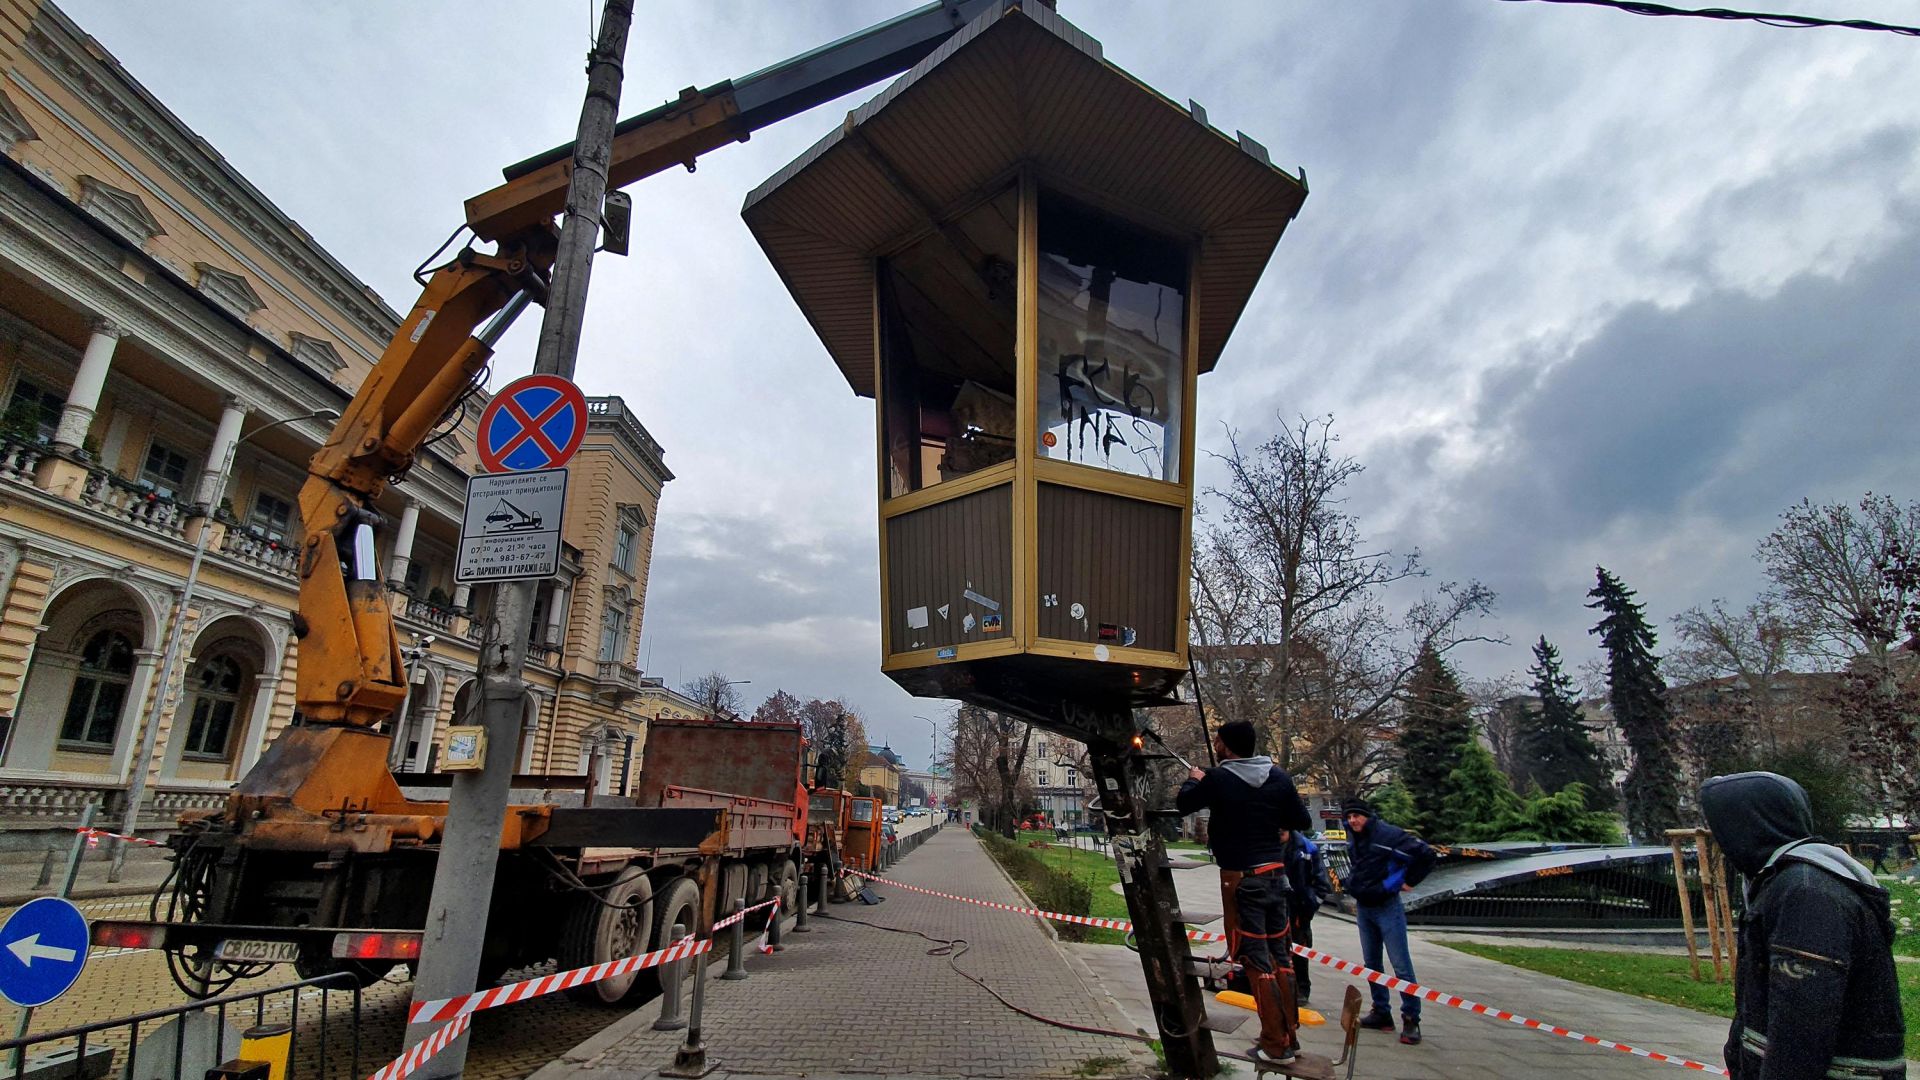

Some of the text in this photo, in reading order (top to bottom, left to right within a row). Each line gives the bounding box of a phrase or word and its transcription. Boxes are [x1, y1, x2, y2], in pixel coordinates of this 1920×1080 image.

[472, 485, 562, 499] отстраняват принудително
[476, 566, 507, 577] ПАРКИНГИ
[514, 564, 538, 574] ГАРАЖИ
